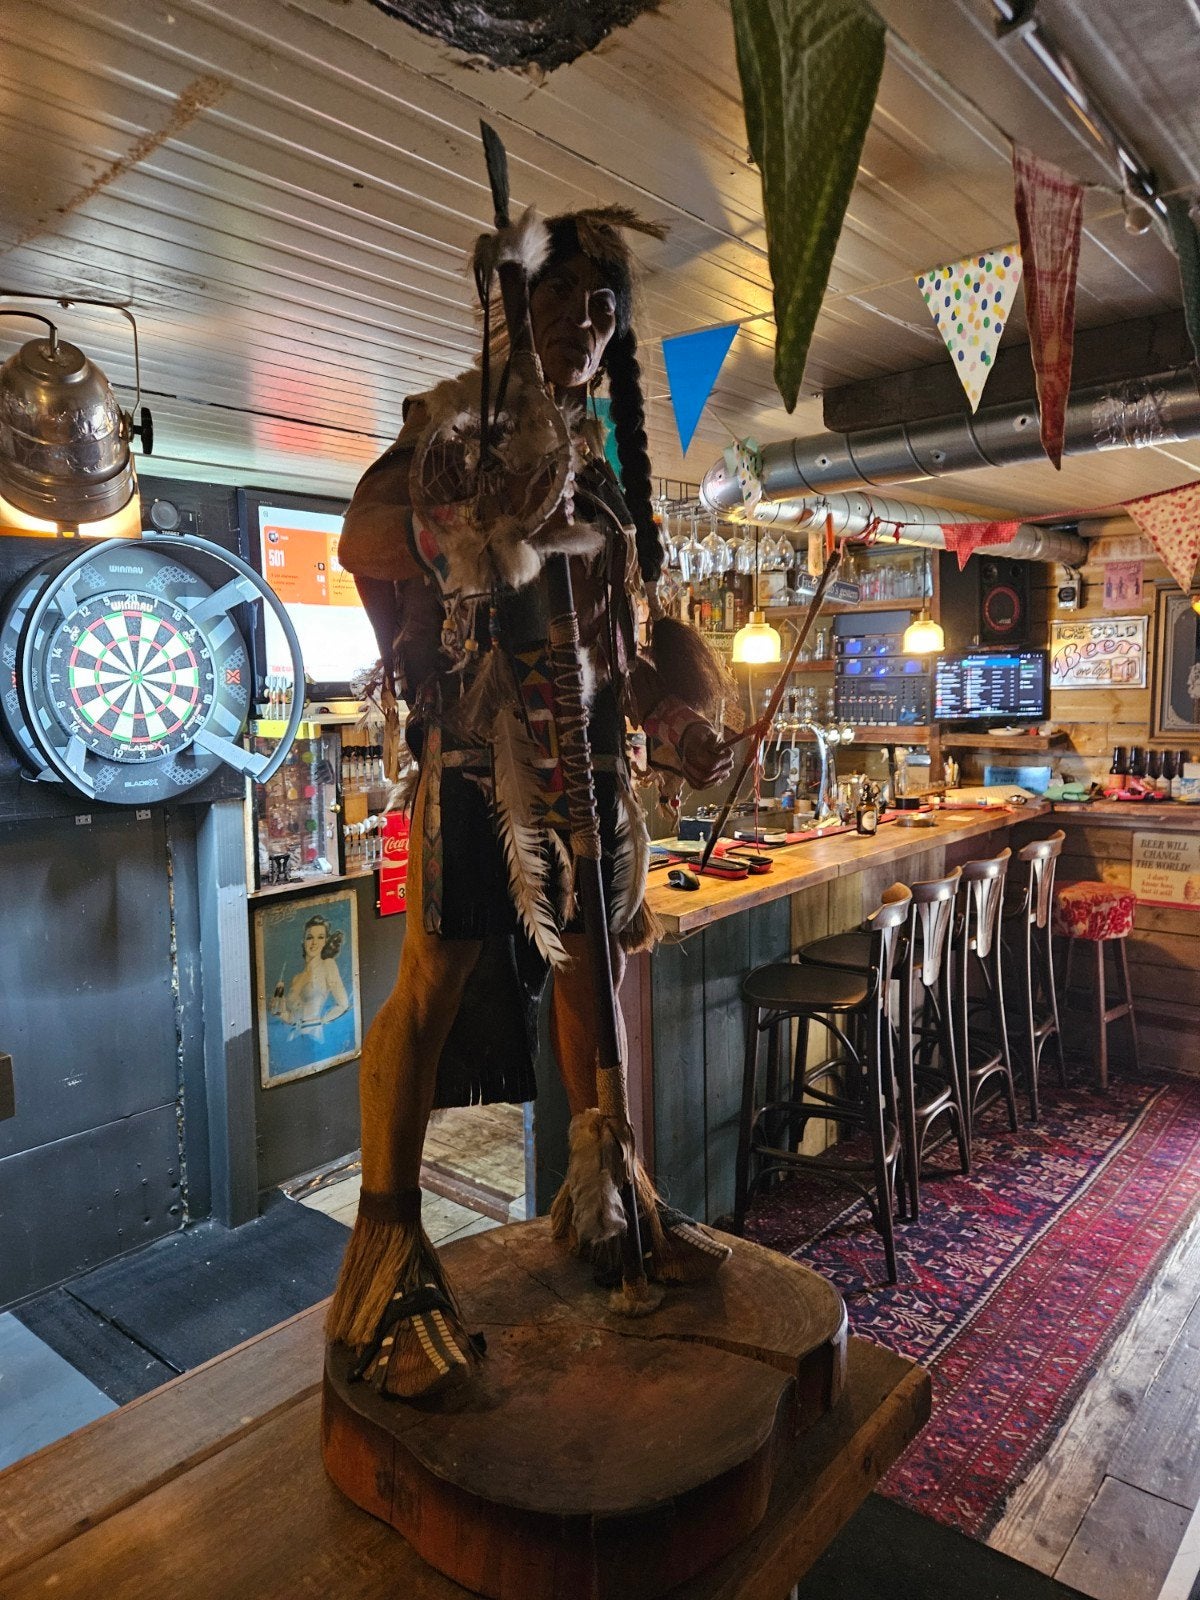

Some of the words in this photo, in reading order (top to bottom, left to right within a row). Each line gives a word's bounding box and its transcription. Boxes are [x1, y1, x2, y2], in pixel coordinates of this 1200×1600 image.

[268, 550, 284, 567] 501
[109, 565, 144, 574] WINMAU
[103, 596, 110, 606] 5
[125, 593, 138, 603] 20
[153, 598, 159, 608] 1
[110, 600, 153, 612] WINMAU
[78, 606, 91, 618] 12
[172, 609, 182, 622] 18
[1056, 626, 1085, 640] ICE
[1090, 624, 1137, 639] COLD
[52, 648, 63, 658] 14
[200, 648, 210, 659] 13
[1052, 639, 1141, 678] Beer
[50, 673, 61, 684] 11
[57, 701, 66, 709] 8
[203, 694, 213, 705] 10
[194, 716, 205, 726] 15
[69, 721, 79, 733] 16
[181, 733, 190, 742] 2
[92, 739, 99, 748] 7
[112, 748, 124, 759] 19
[140, 751, 146, 760] 3
[162, 744, 170, 756] 17
[1140, 839, 1165, 849] BEER
[1166, 841, 1189, 851] WILL
[1143, 850, 1182, 861] CHANGE
[1136, 860, 1153, 868] THE
[1156, 862, 1191, 872] WORLD!
[399, 887, 405, 898] 3
